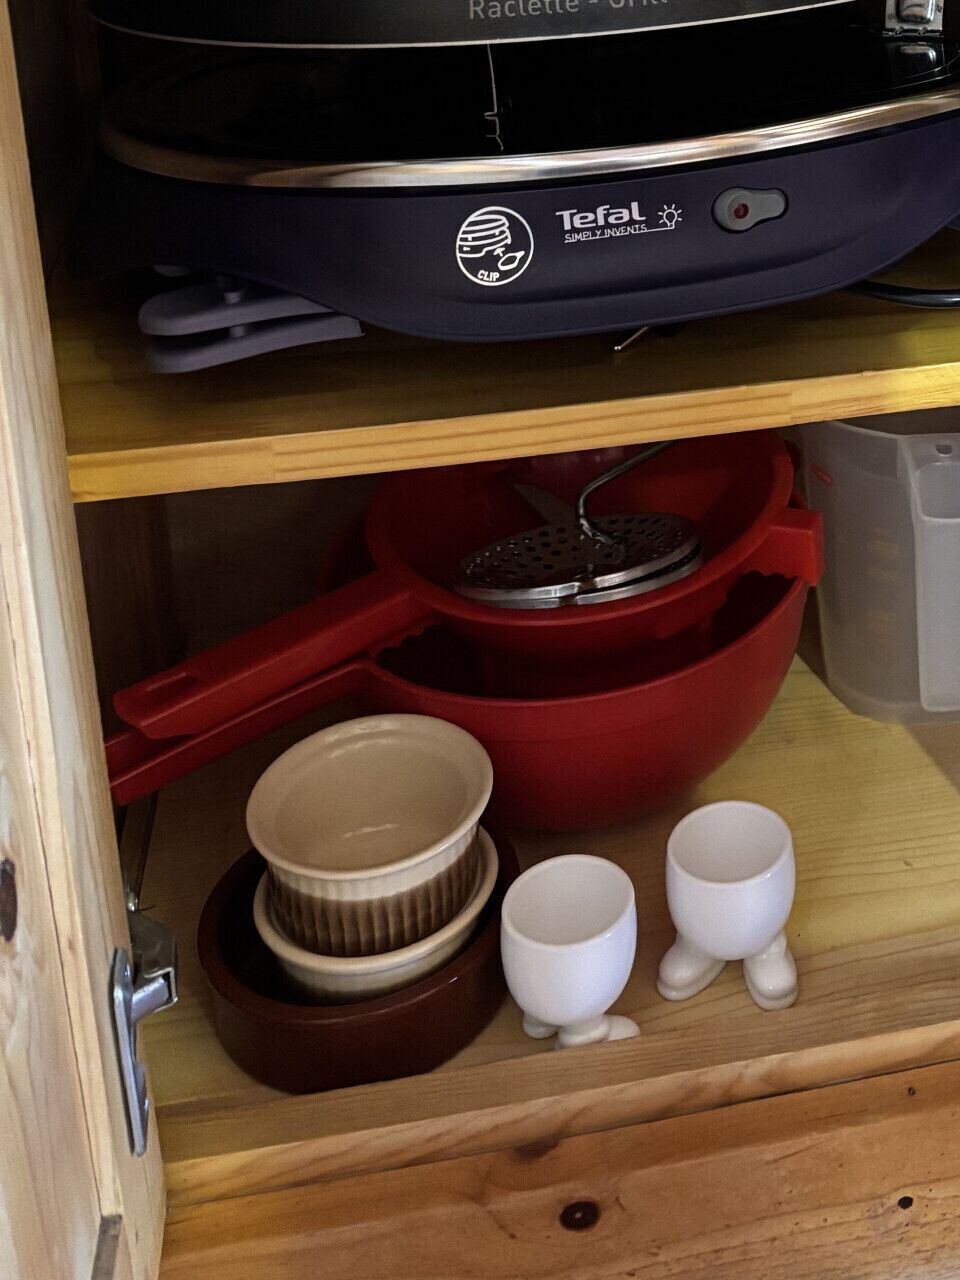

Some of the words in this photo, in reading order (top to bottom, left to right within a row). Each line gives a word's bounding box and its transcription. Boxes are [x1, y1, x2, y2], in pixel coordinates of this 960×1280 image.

[555, 202, 647, 231] Tefal
[564, 228, 602, 243] SIMPLY
[604, 223, 648, 239] INVENTS
[477, 269, 500, 282] CLIP
